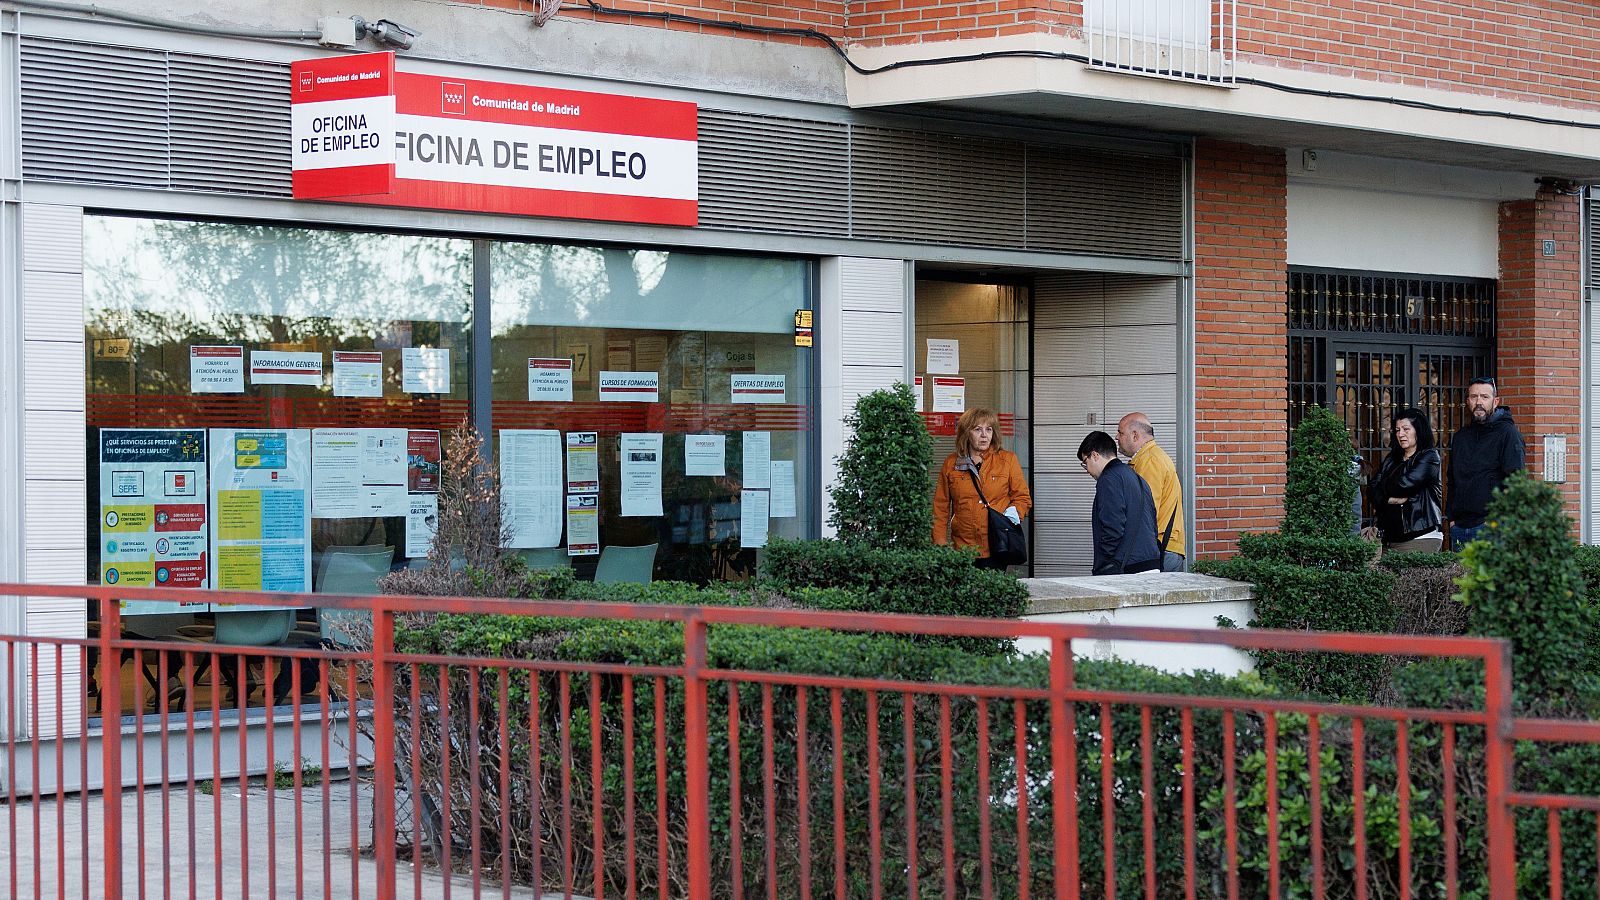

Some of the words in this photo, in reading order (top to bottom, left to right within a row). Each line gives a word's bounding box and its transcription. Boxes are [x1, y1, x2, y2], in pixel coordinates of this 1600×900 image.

[316, 74, 350, 84] Comunidad
[359, 70, 381, 79] Madrid
[472, 95, 529, 111] Comunidad
[531, 102, 544, 113] de
[546, 103, 580, 116] Madrid
[312, 114, 368, 133] OFICINA
[301, 137, 319, 153] DE
[323, 132, 380, 152] EMPLEO
[395, 131, 484, 167] FICINA
[493, 140, 529, 171] DE
[538, 144, 647, 180] EMPLEO
[1407, 298, 1423, 316] 57
[252, 358, 295, 368] INFORMACIÓN
[295, 360, 321, 368] GENERAL
[601, 379, 620, 387] CURSOS
[620, 379, 627, 387] DE
[627, 378, 658, 387] FORMACIÓN
[733, 380, 756, 388] OFERTAS
[756, 380, 763, 388] DE
[118, 484, 138, 494] SEPE
